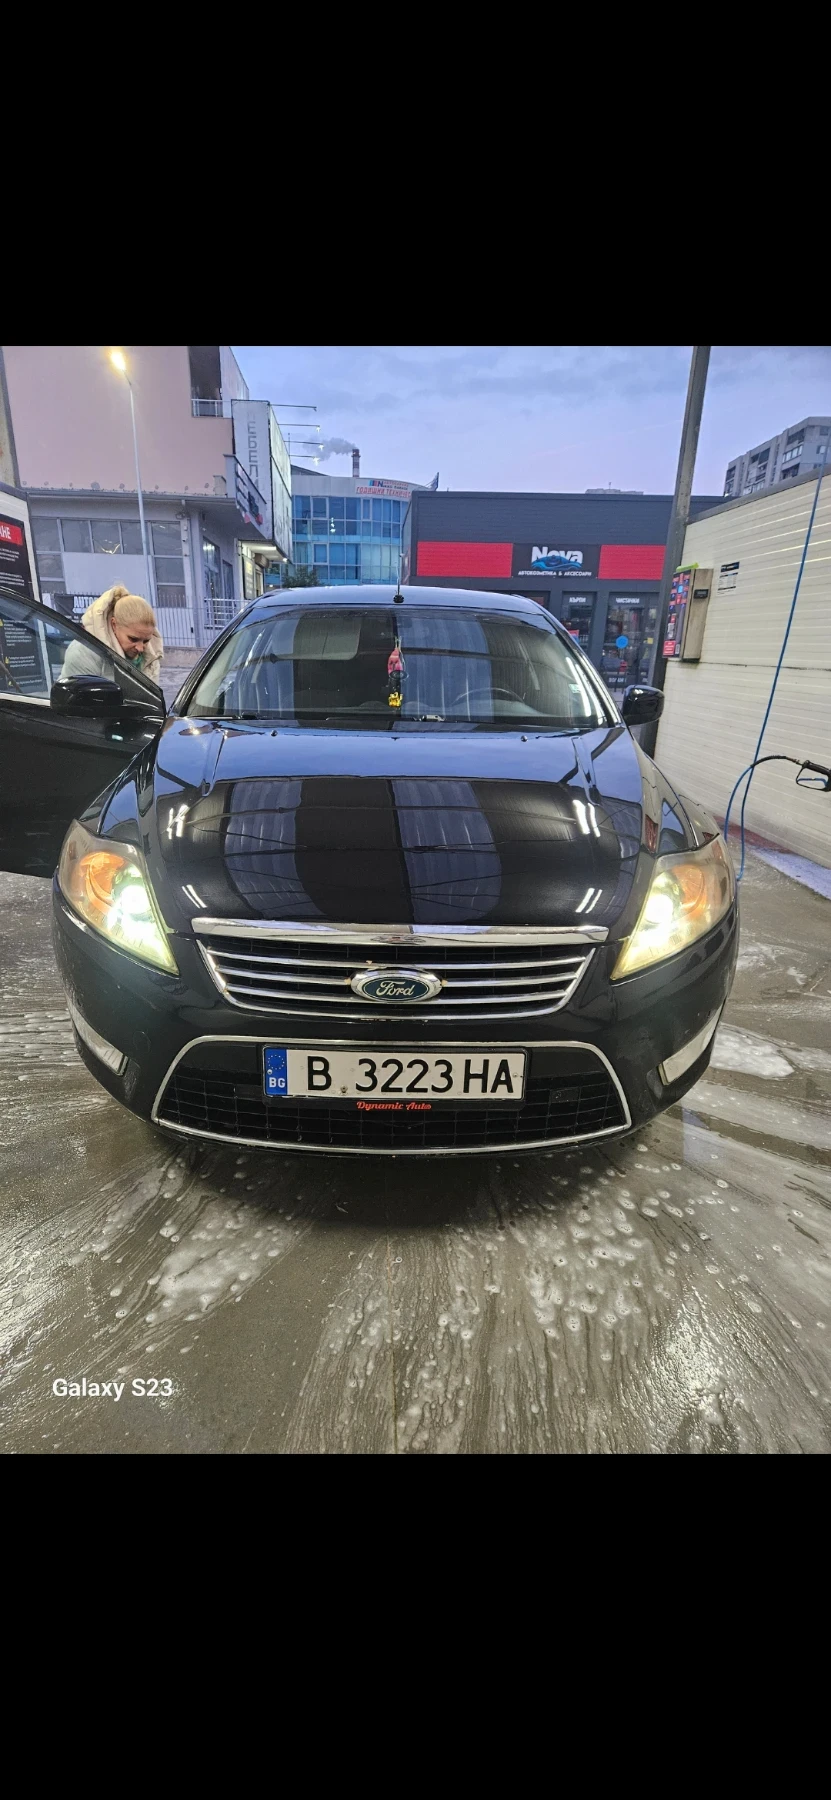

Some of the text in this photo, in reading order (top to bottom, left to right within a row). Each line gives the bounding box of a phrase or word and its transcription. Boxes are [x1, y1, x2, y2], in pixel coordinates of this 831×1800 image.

[531, 546, 583, 564] Nova
[376, 980, 415, 996] Ford
[268, 1077, 286, 1088] BG
[307, 1056, 514, 1093] B 3223 HA
[356, 1101, 432, 1111] Dynamic Auto
